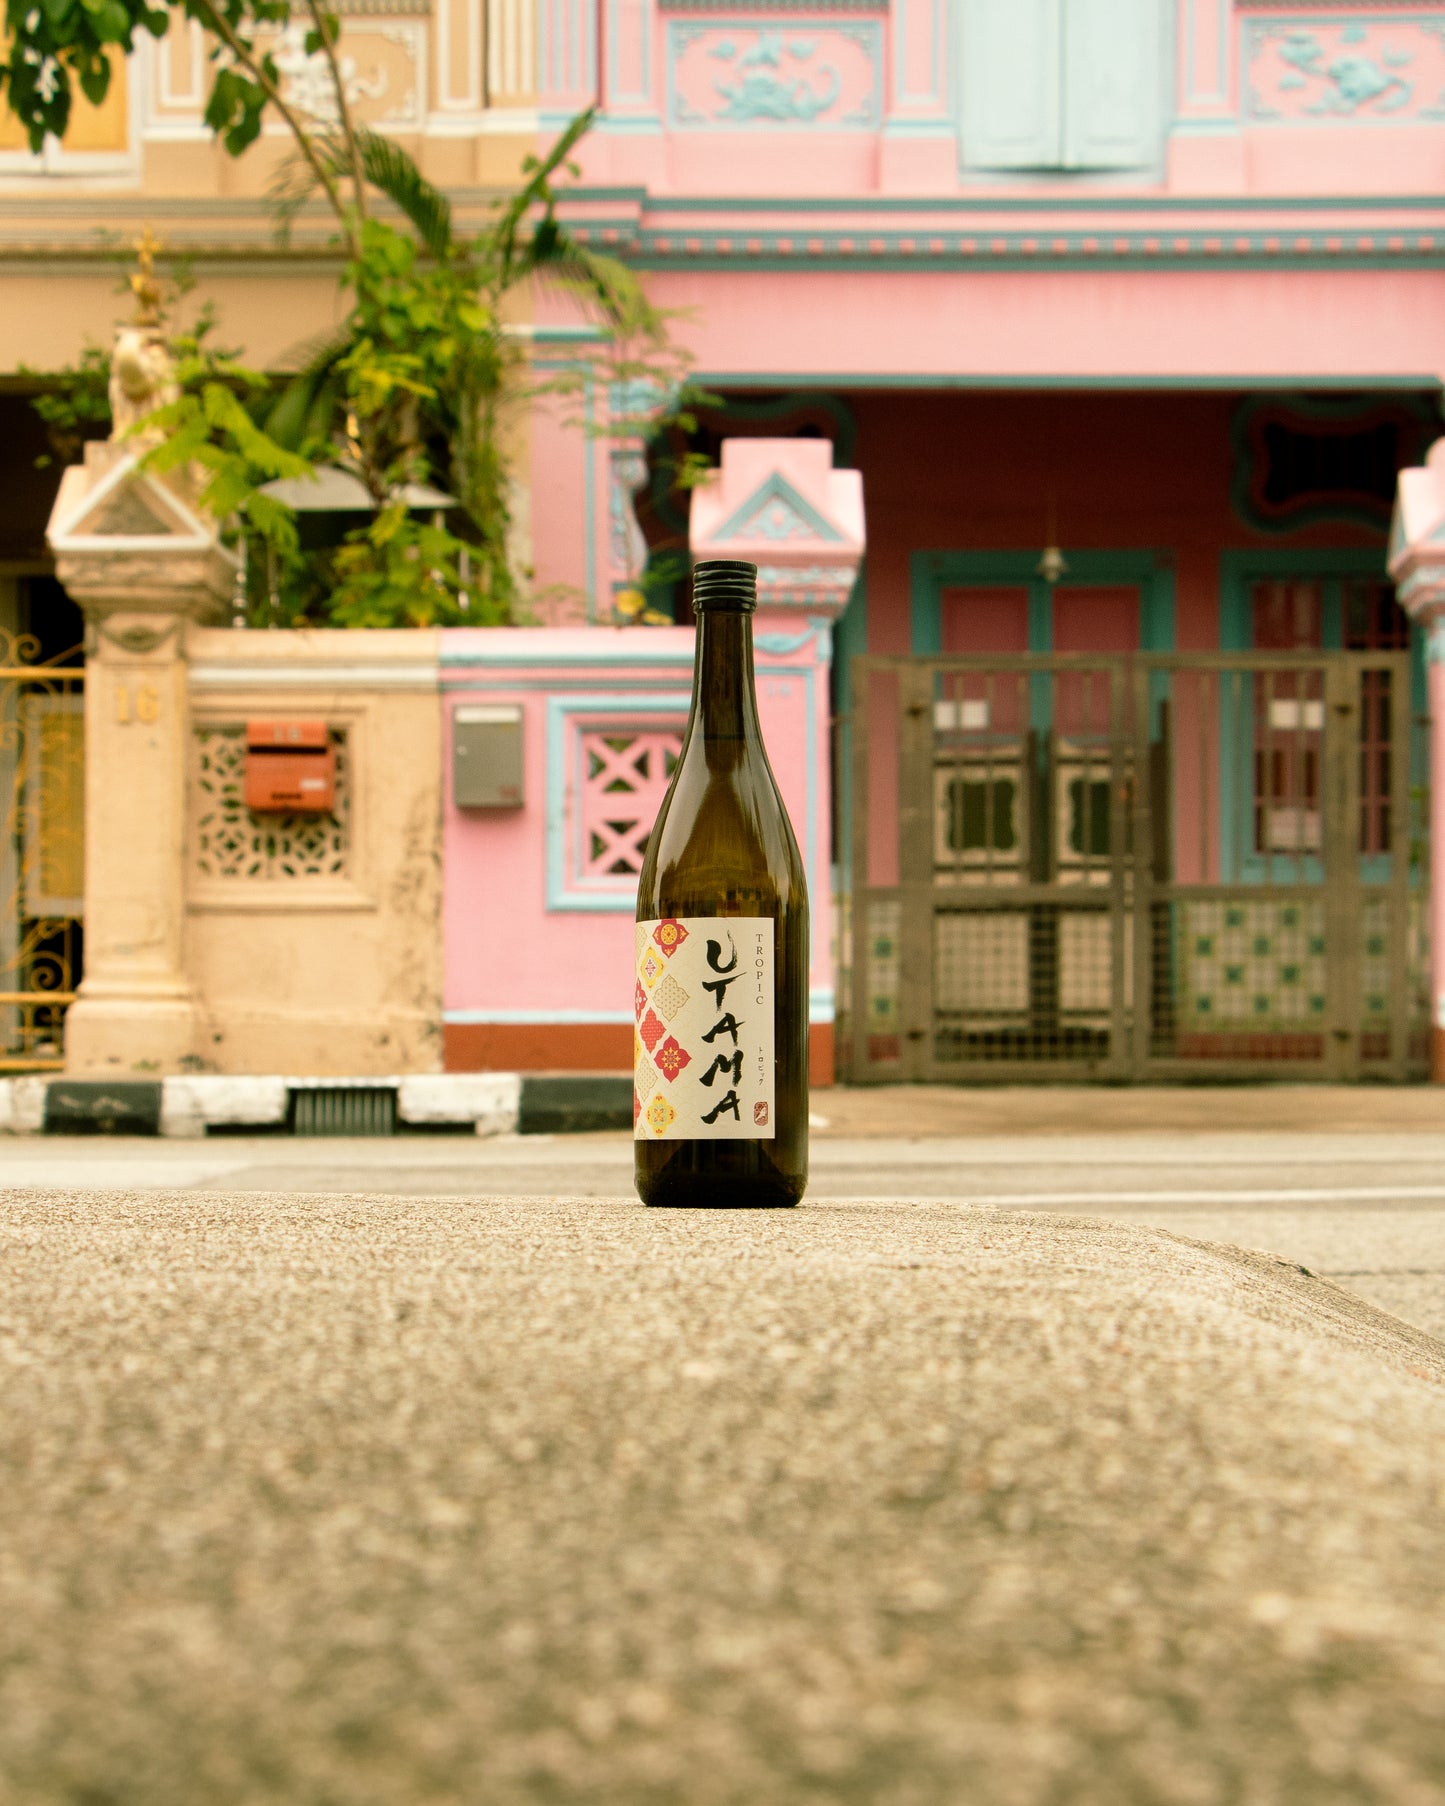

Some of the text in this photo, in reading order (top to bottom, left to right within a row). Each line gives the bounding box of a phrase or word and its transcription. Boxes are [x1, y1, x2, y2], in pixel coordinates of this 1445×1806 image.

[115, 686, 159, 722] 16
[755, 933, 764, 1005] TROPIC
[699, 929, 747, 1125] UTAMA
